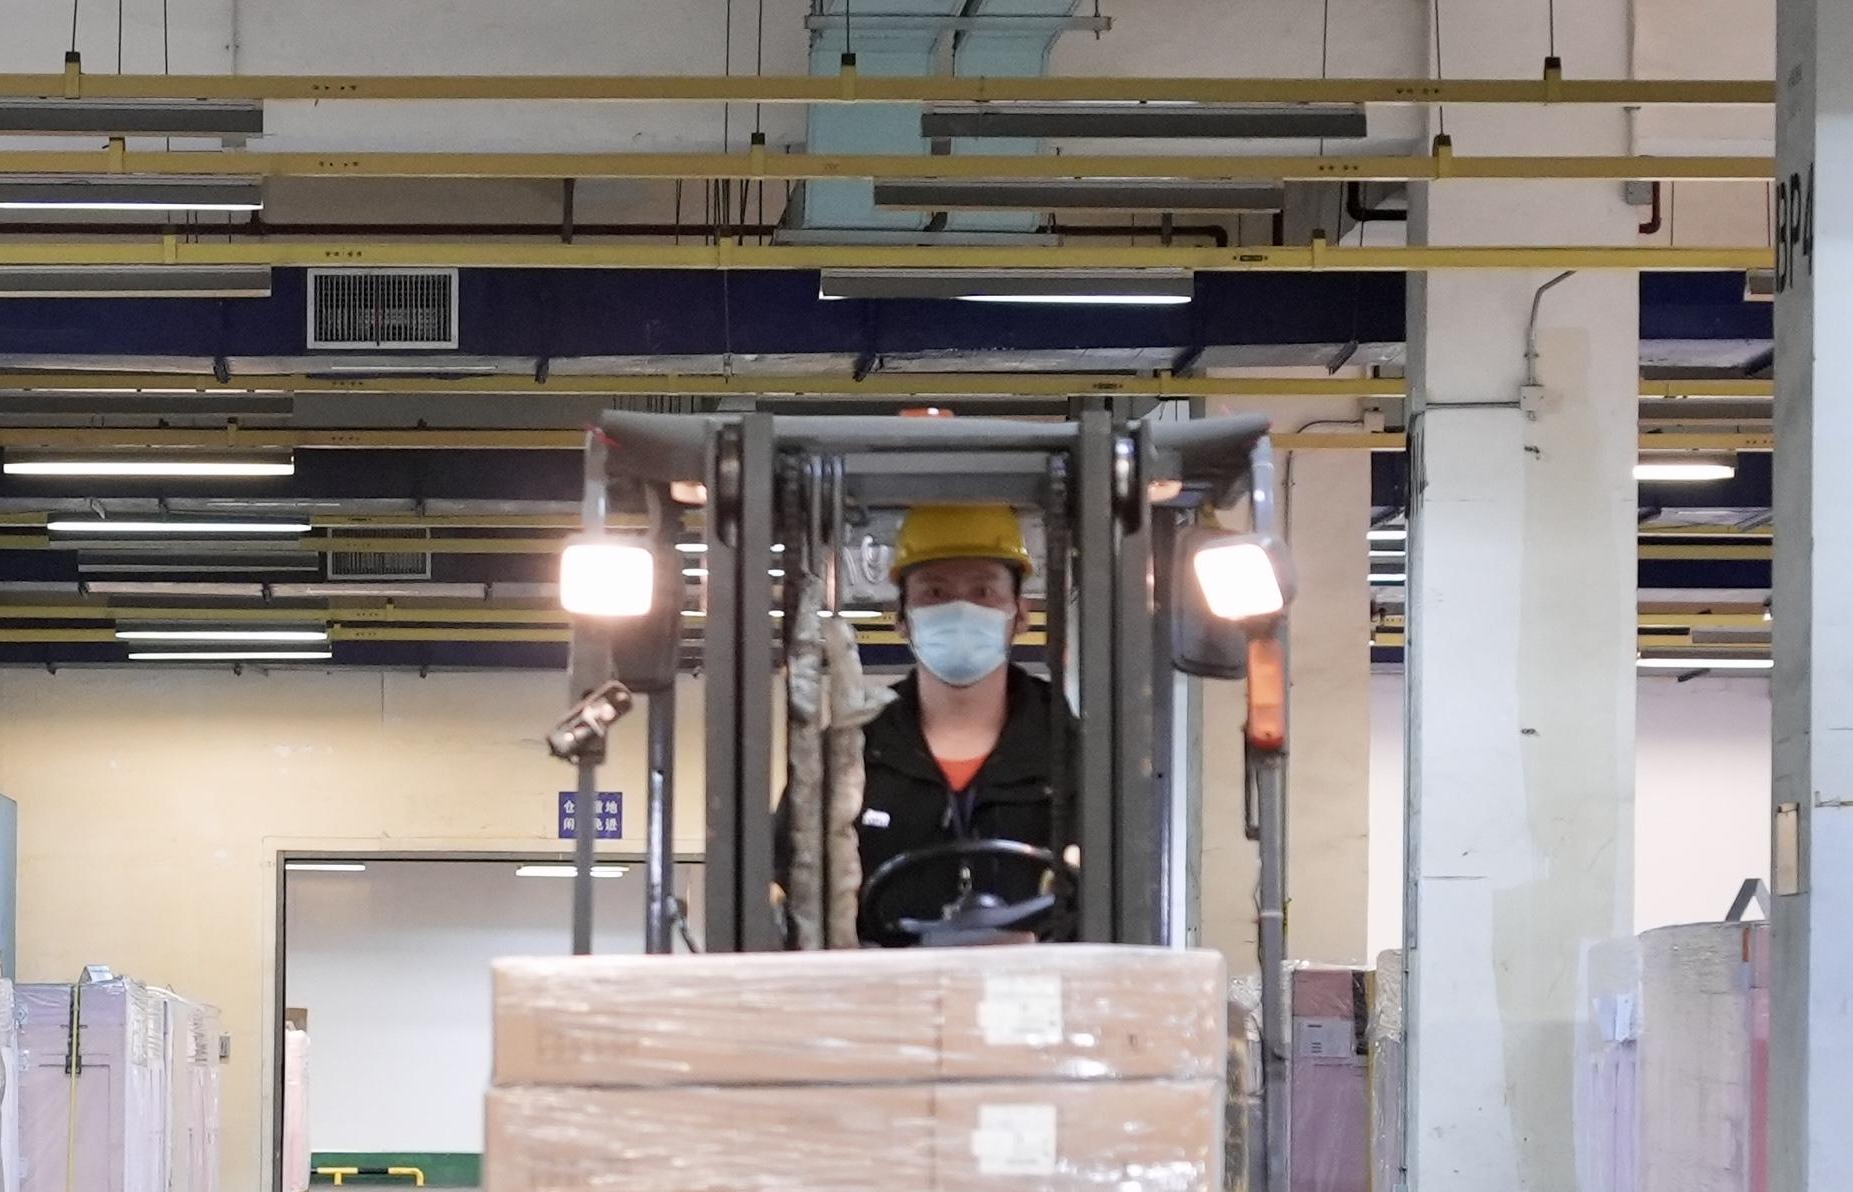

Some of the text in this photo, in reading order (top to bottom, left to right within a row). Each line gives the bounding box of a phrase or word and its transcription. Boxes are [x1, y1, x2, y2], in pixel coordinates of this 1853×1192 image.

[1775, 161, 1814, 294] BP4
[563, 799, 618, 814] 仓重地
[563, 817, 618, 831] 闲免进
